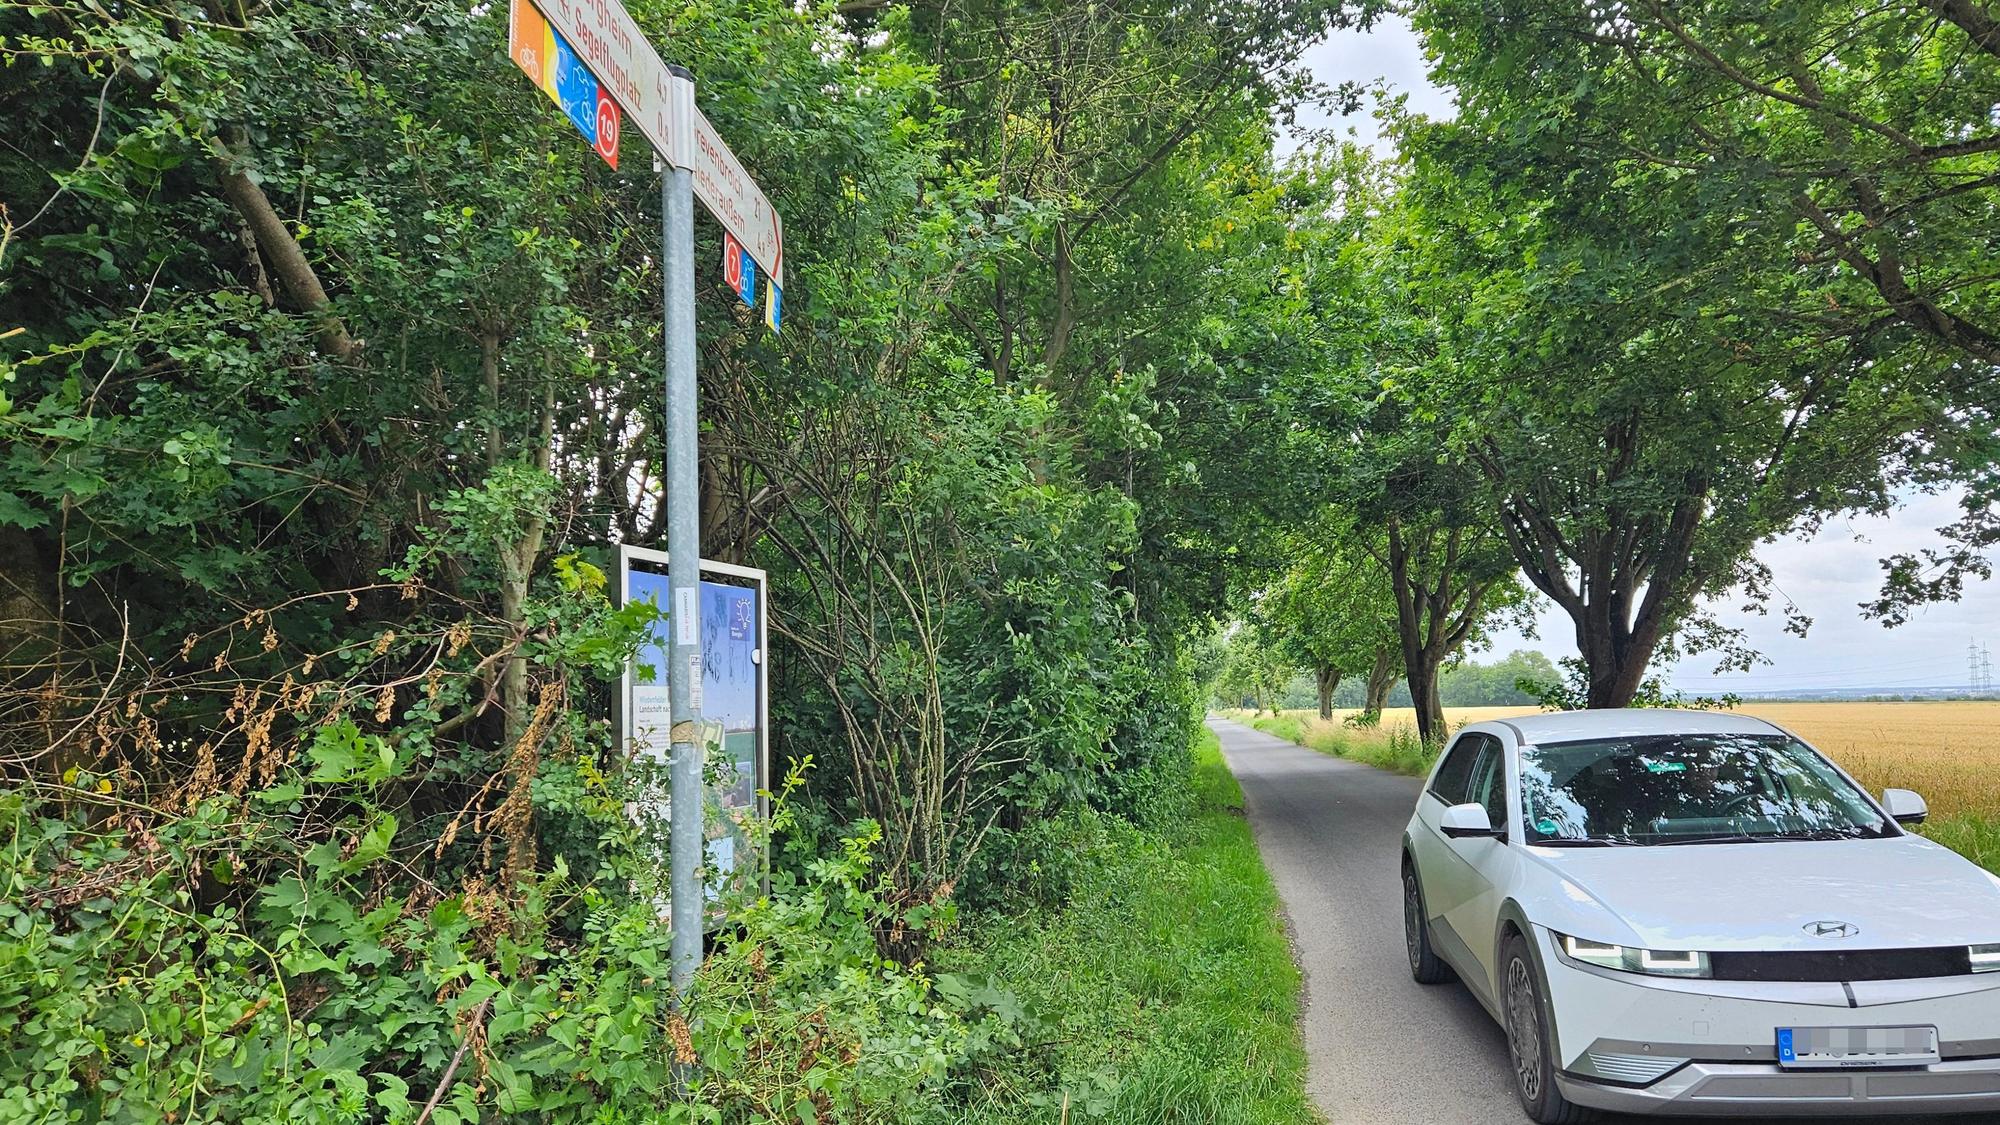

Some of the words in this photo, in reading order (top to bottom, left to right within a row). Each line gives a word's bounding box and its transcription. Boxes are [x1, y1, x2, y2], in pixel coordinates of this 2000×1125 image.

[575, 6, 642, 112] Segelflugplatz
[600, 113, 614, 142] 19
[694, 123, 744, 201] revenbroich
[731, 254, 737, 272] 7
[1784, 1048, 1791, 1056] D
